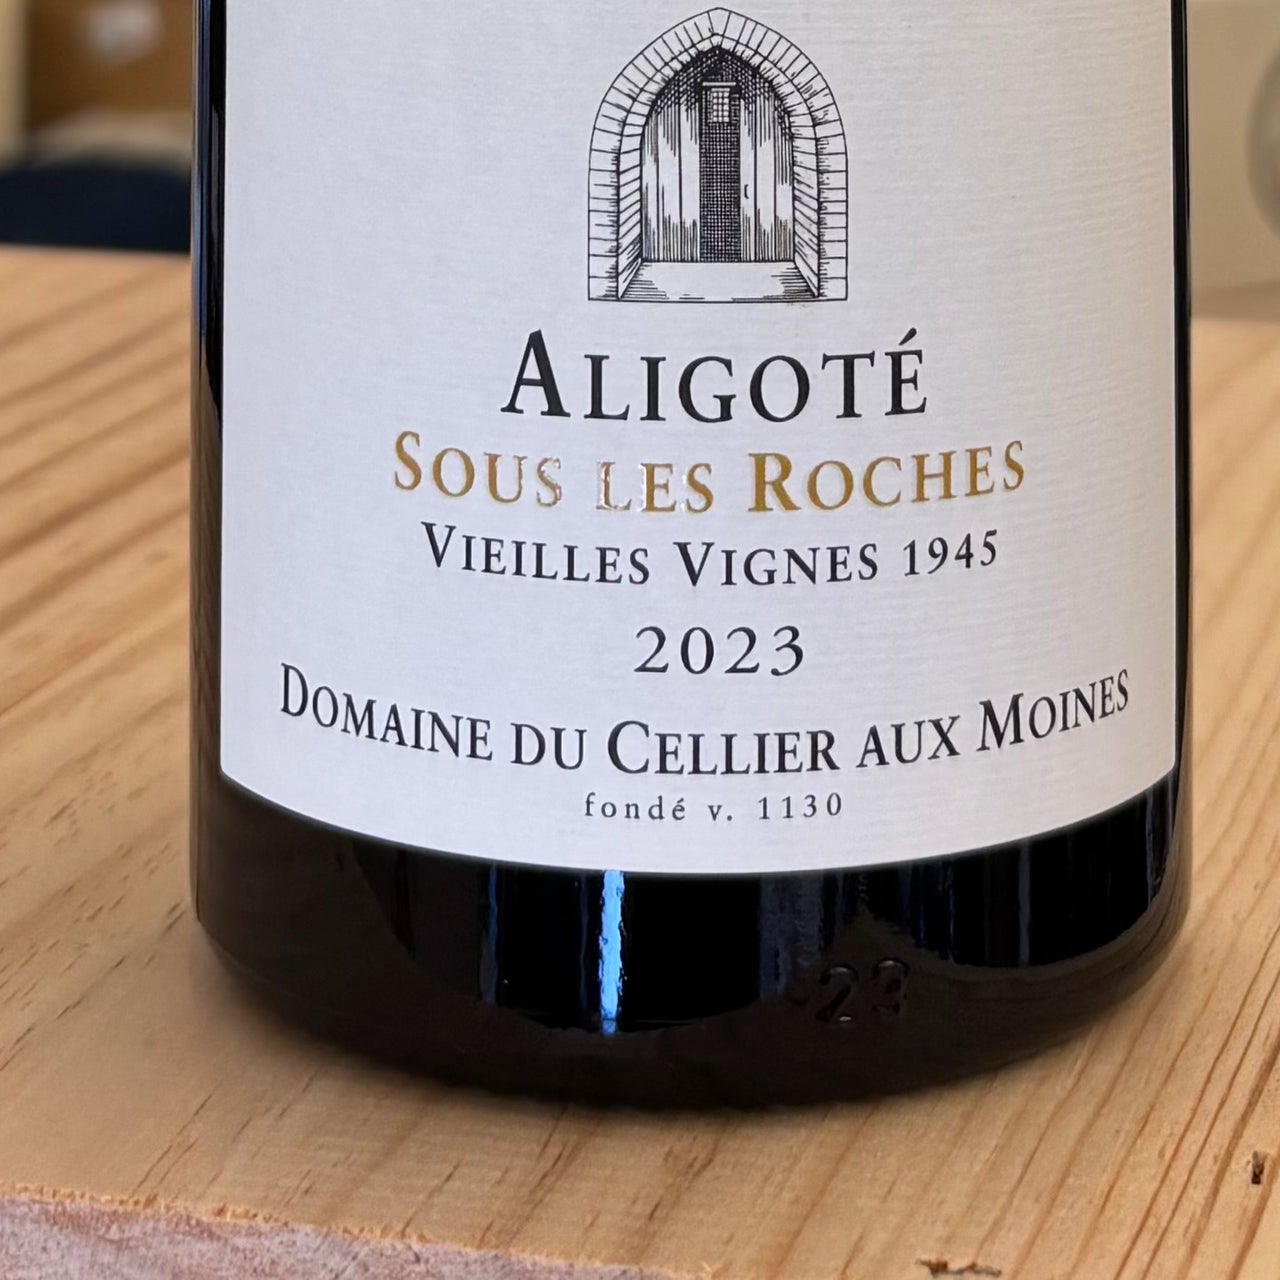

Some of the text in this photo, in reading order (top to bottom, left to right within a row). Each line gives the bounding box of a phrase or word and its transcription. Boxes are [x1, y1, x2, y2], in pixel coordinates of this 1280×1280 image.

[501, 328, 927, 423] ALIGOTÉ
[394, 431, 1024, 515] SOUS LES ROCHES
[421, 521, 997, 586] VIEILLES VIGNES 1945
[634, 626, 803, 676] 2023
[281, 663, 1128, 775] DOMAINE DU CELLIER AUX MOINES
[585, 792, 841, 821] fondé v. 1130
